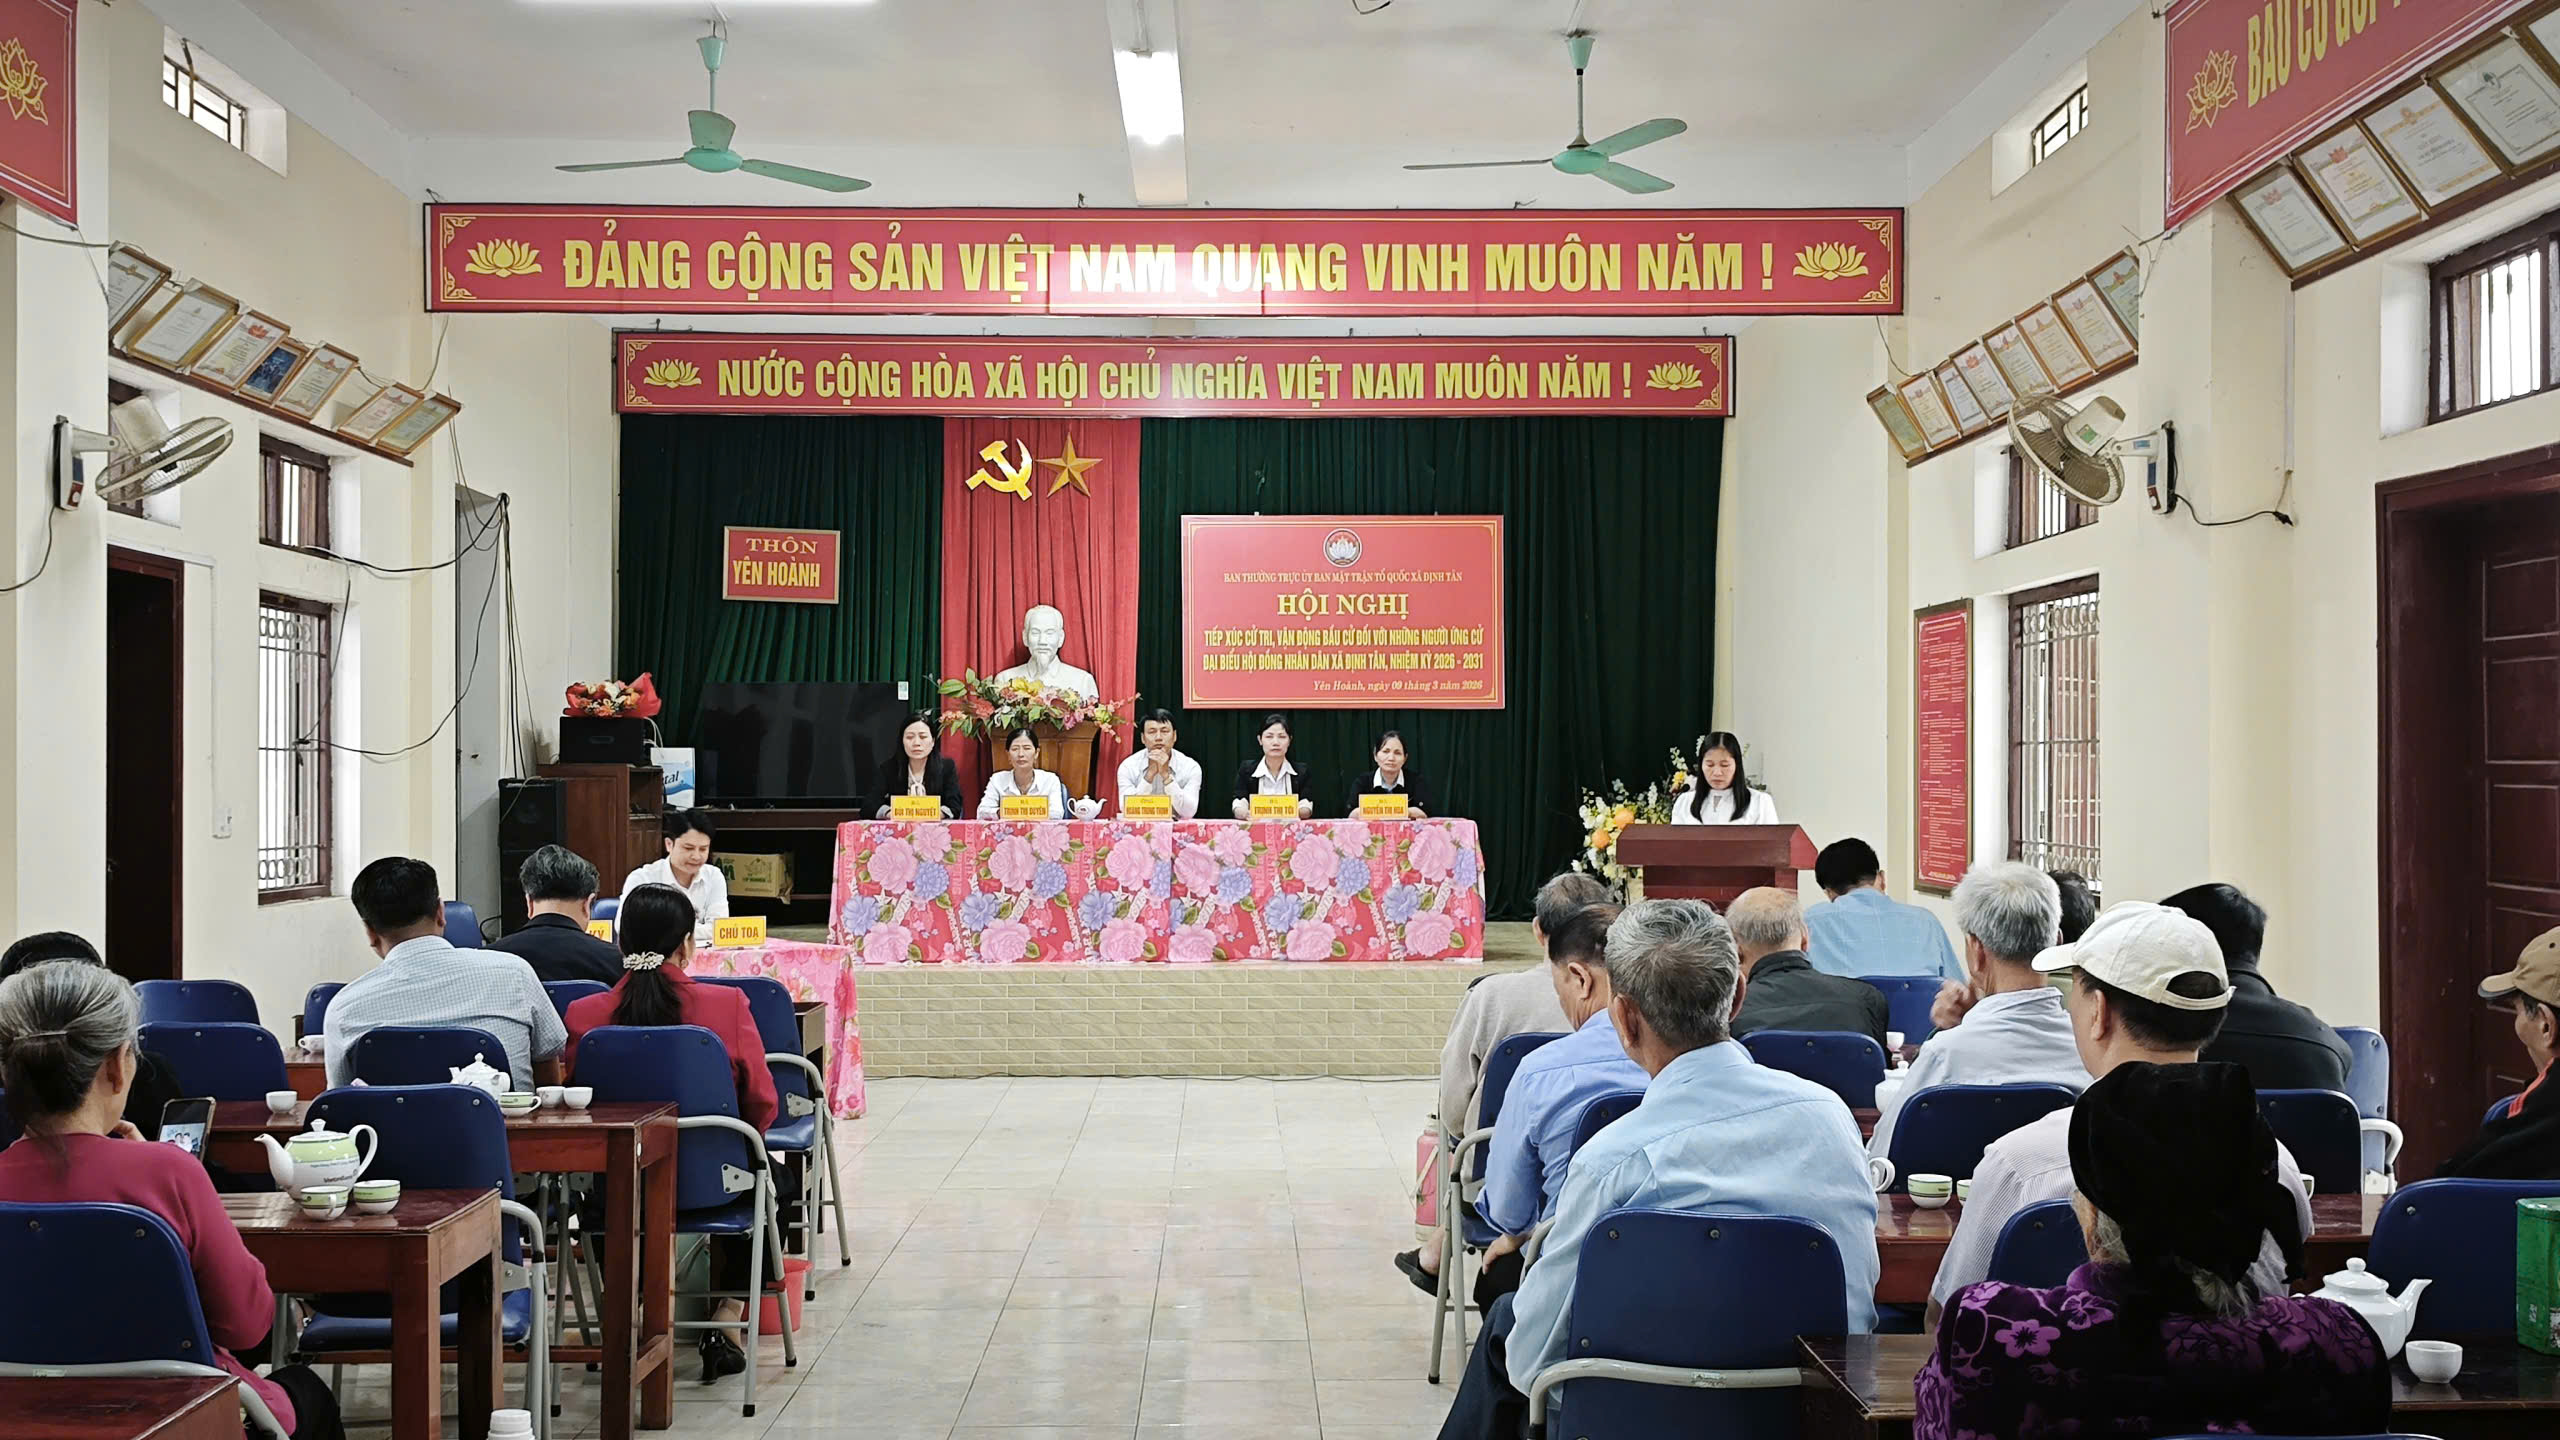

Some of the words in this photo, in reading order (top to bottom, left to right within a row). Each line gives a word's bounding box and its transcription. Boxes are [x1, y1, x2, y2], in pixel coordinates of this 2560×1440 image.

[563, 219, 691, 289] ĐẢNG
[707, 231, 832, 300] CỘNG
[849, 221, 943, 291] SẢN
[958, 233, 1055, 303] VIỆT
[1069, 244, 1177, 292] NAM
[1191, 243, 1348, 298] QUANG
[1362, 243, 1469, 292] VINH
[1485, 232, 1621, 292] MUÔN
[1637, 232, 1743, 292] NĂM
[1761, 242, 1773, 291] !
[718, 348, 804, 398] NƯỚC
[815, 352, 901, 406] CỘNG
[911, 352, 976, 399] HÒA
[984, 354, 1027, 399] XÃ
[1036, 354, 1089, 408] HỘI
[1099, 347, 1161, 400] CHỦ
[1171, 355, 1269, 401] NGHĨA
[1277, 355, 1343, 409] VIỆT
[1352, 362, 1425, 400] NAM
[1435, 353, 1528, 400] MUÔN
[1539, 353, 1610, 399] NĂM
[1623, 361, 1632, 399] !
[745, 535, 818, 555] THÔN
[732, 555, 764, 586] YÊN
[767, 555, 820, 588] HOÀNH
[1223, 573, 1240, 583] BAN
[1314, 572, 1331, 583] BAN
[1277, 587, 1330, 622] HỘI
[1335, 593, 1409, 620] NGHỊ
[1204, 624, 1224, 647] TIẾP
[1225, 626, 1244, 647] XÚC
[1244, 624, 1258, 646] CỬ
[1259, 630, 1276, 648] TRI,
[1276, 626, 1295, 650] VẬN
[1296, 626, 1321, 650] ĐỘNG
[1342, 624, 1356, 646] CỬ
[1356, 624, 1372, 646] ĐỐI
[1373, 625, 1388, 646] VỚI
[1389, 625, 1420, 646] NHỮNG
[1421, 625, 1449, 646] NGƯỜI
[1450, 625, 1469, 646] ỨNG
[1470, 623, 1484, 646] CỬ
[1203, 653, 1219, 674] ĐẠI
[1219, 648, 1241, 671] BIỂU
[1241, 650, 1257, 674] HỘI
[1258, 648, 1283, 671] ĐỒNG
[1284, 650, 1310, 670] NHÂN
[1311, 650, 1330, 670] DÂN
[1331, 650, 1344, 670] XÃ
[1345, 653, 1367, 674] ĐỊNH
[1368, 650, 1389, 672] TÂN,
[1390, 649, 1419, 673] NHIỆM
[1420, 649, 1432, 670] KỲ
[1433, 653, 1455, 670] 2026
[1462, 653, 1484, 670] 2031
[1313, 680, 1331, 690] Yên
[1404, 680, 1431, 692] tháng
[1440, 680, 1461, 690] năm
[1462, 679, 1484, 690] 2026
